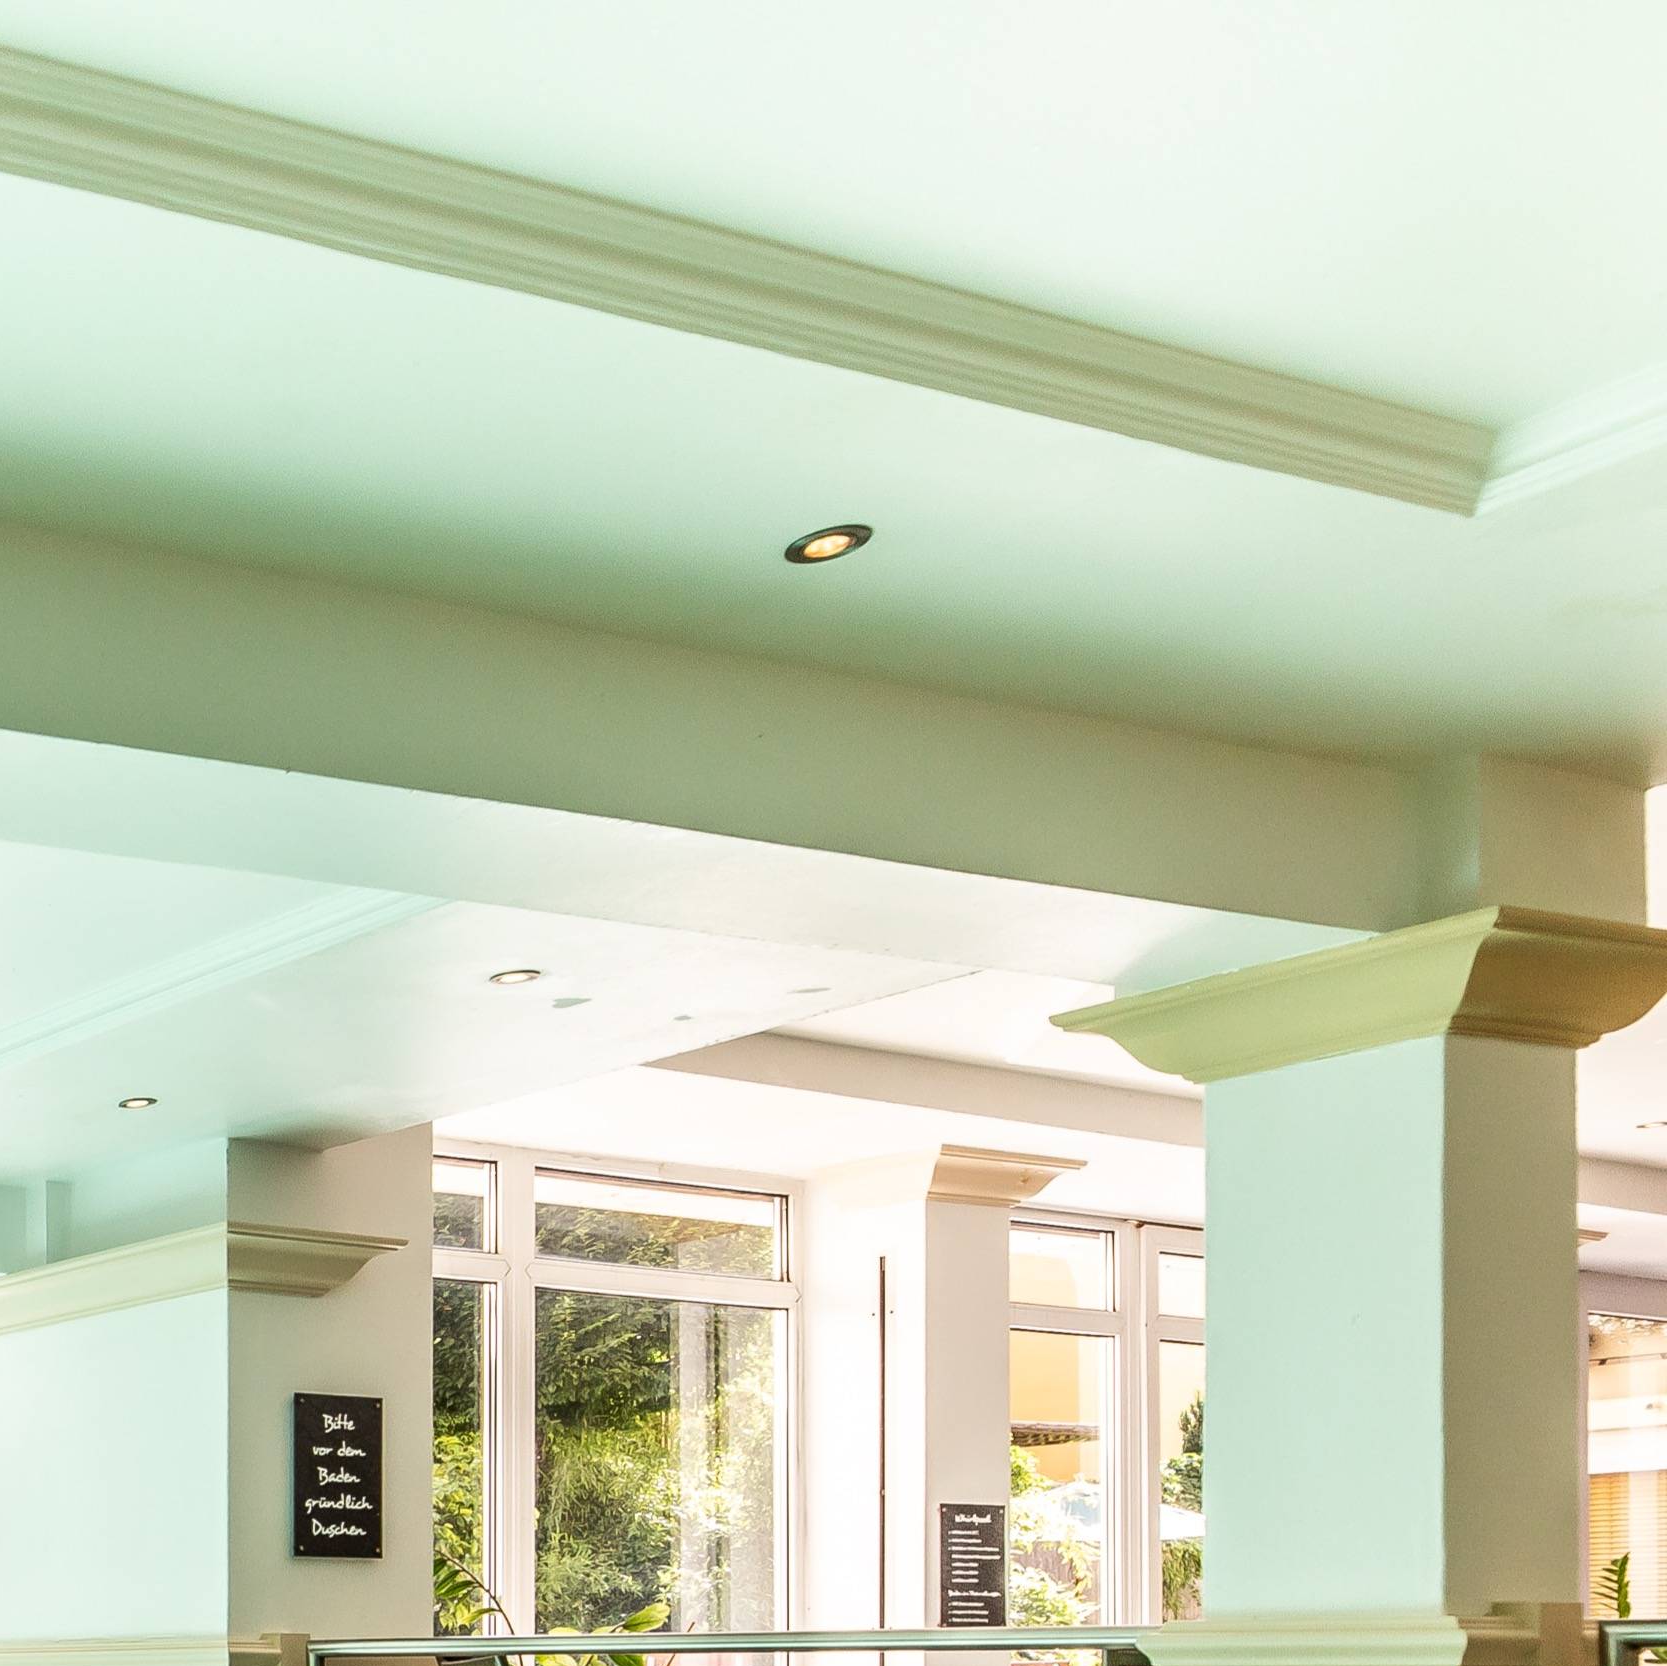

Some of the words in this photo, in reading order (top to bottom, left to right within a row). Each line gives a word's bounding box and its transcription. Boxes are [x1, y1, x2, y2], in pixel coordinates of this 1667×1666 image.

[322, 1413, 356, 1433] Bitte
[312, 1445, 334, 1457] vor
[336, 1441, 367, 1457] dem
[316, 1466, 361, 1486] Baden
[304, 1493, 374, 1514] gründlich
[311, 1518, 367, 1538] Duschen
